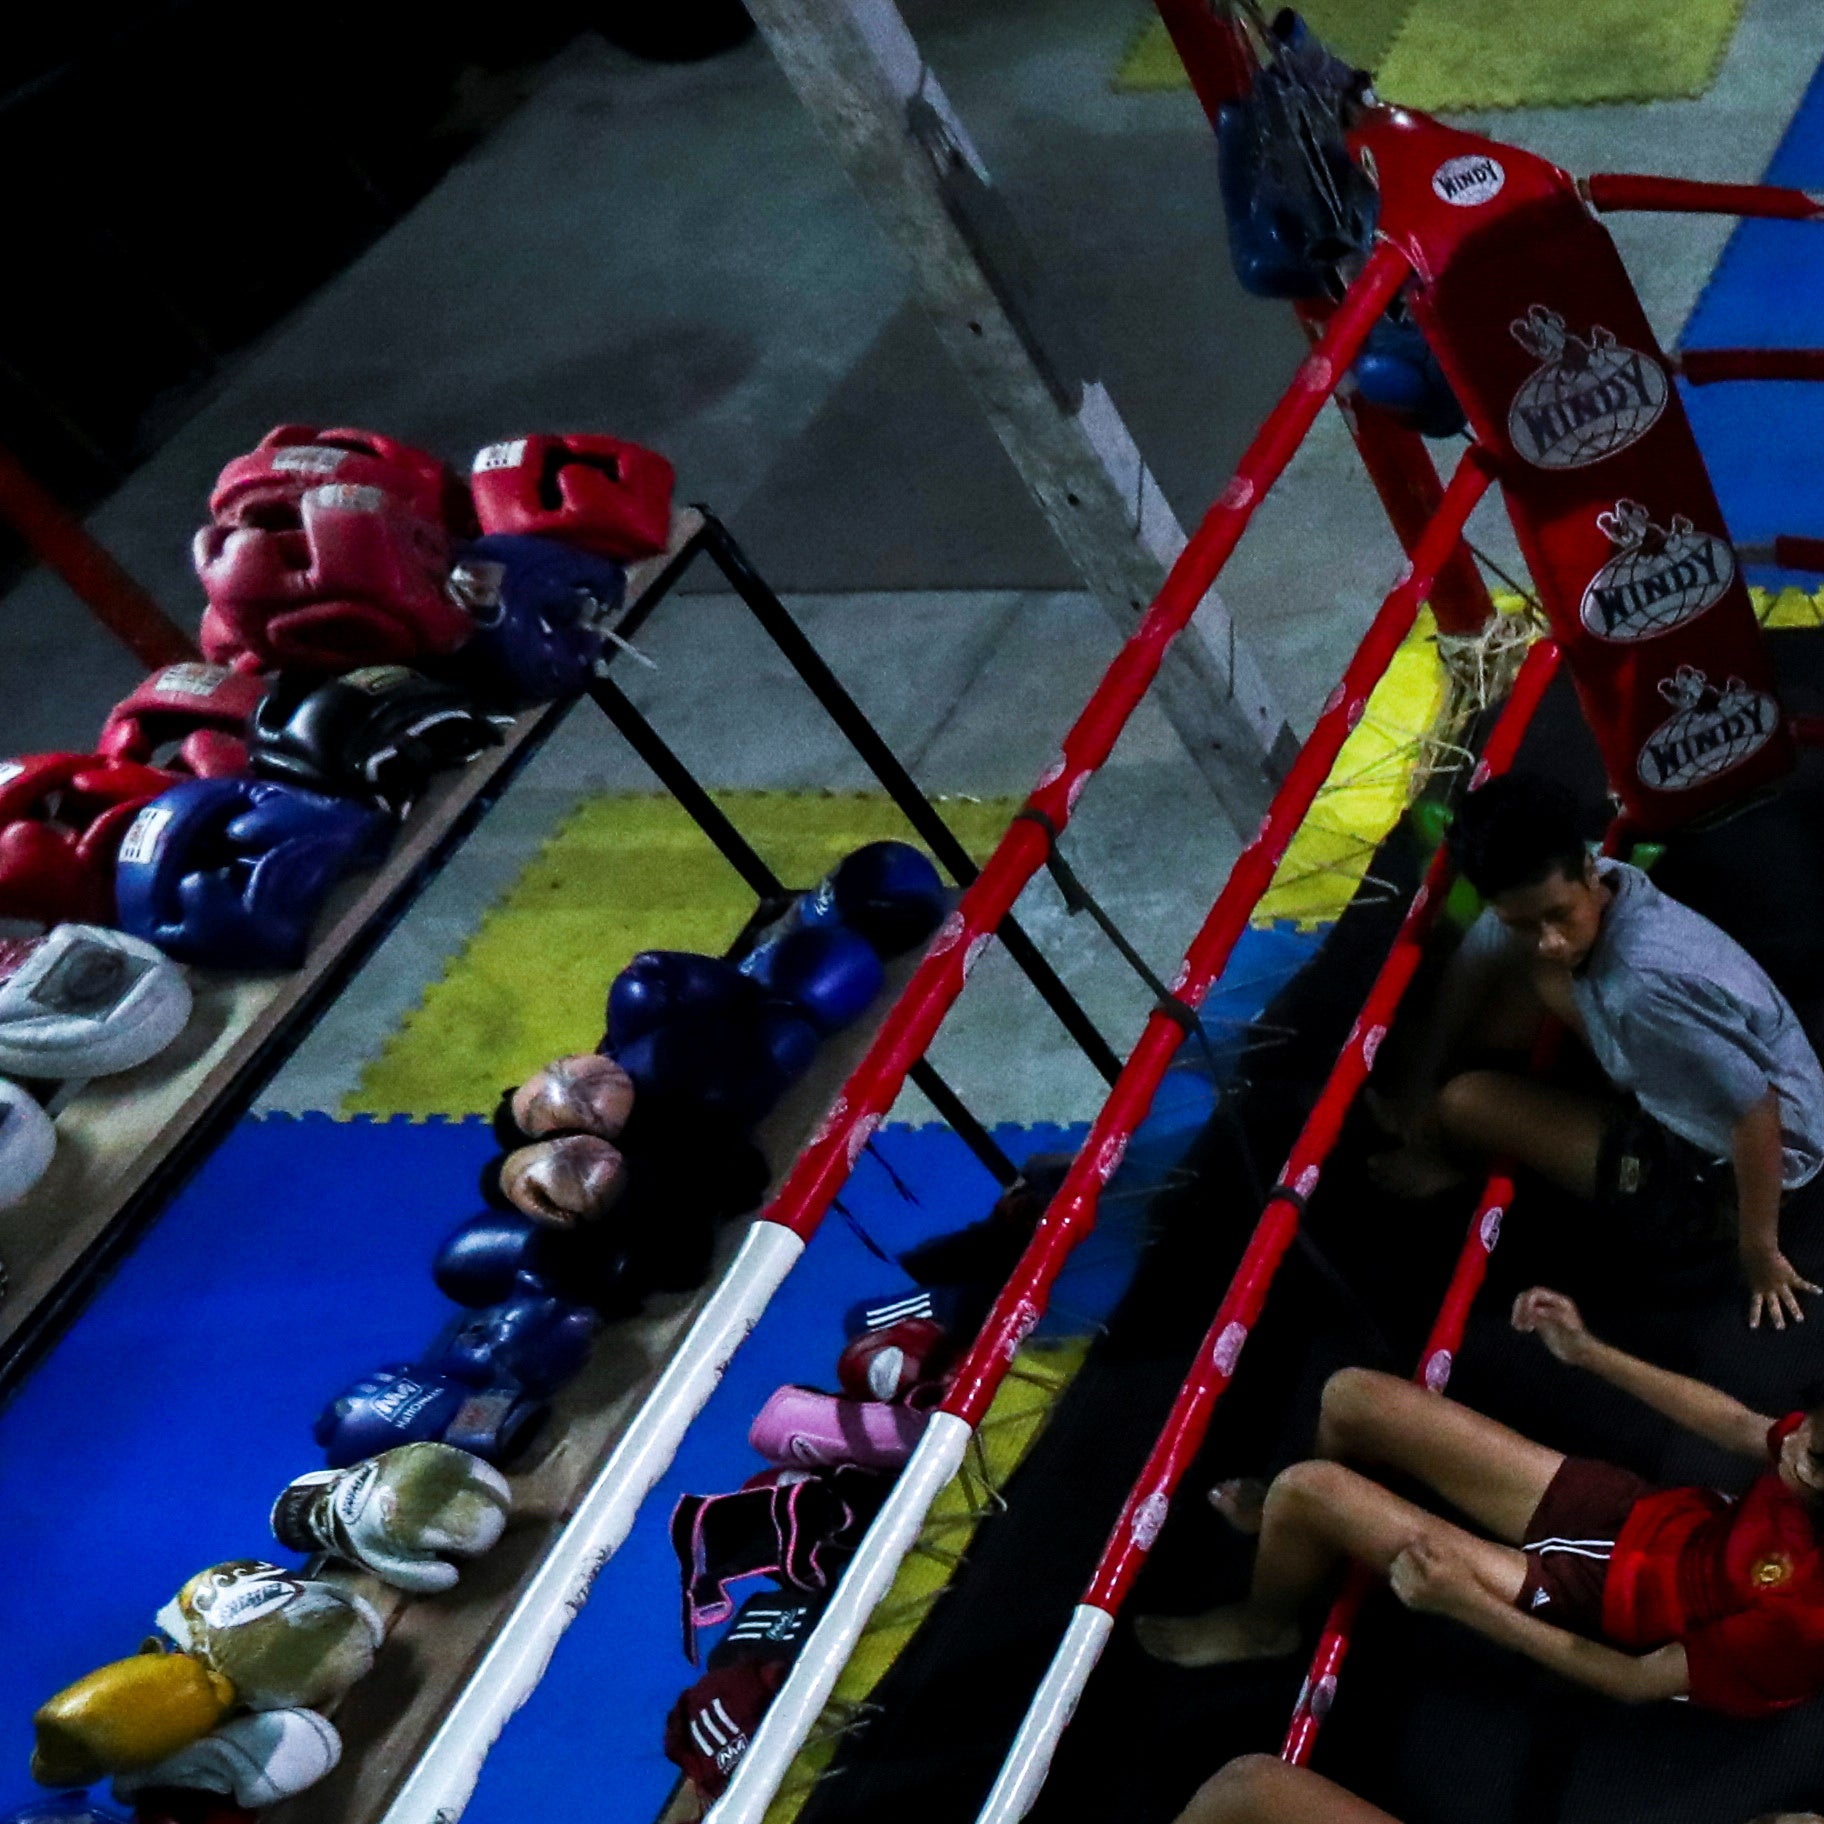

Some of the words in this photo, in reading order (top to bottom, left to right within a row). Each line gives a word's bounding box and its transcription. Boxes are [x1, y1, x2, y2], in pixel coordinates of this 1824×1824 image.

[1437, 160, 1498, 197] WINDY
[1518, 354, 1651, 457] WINDY
[1592, 537, 1719, 630] WINDY
[1650, 696, 1763, 783] WINDY
